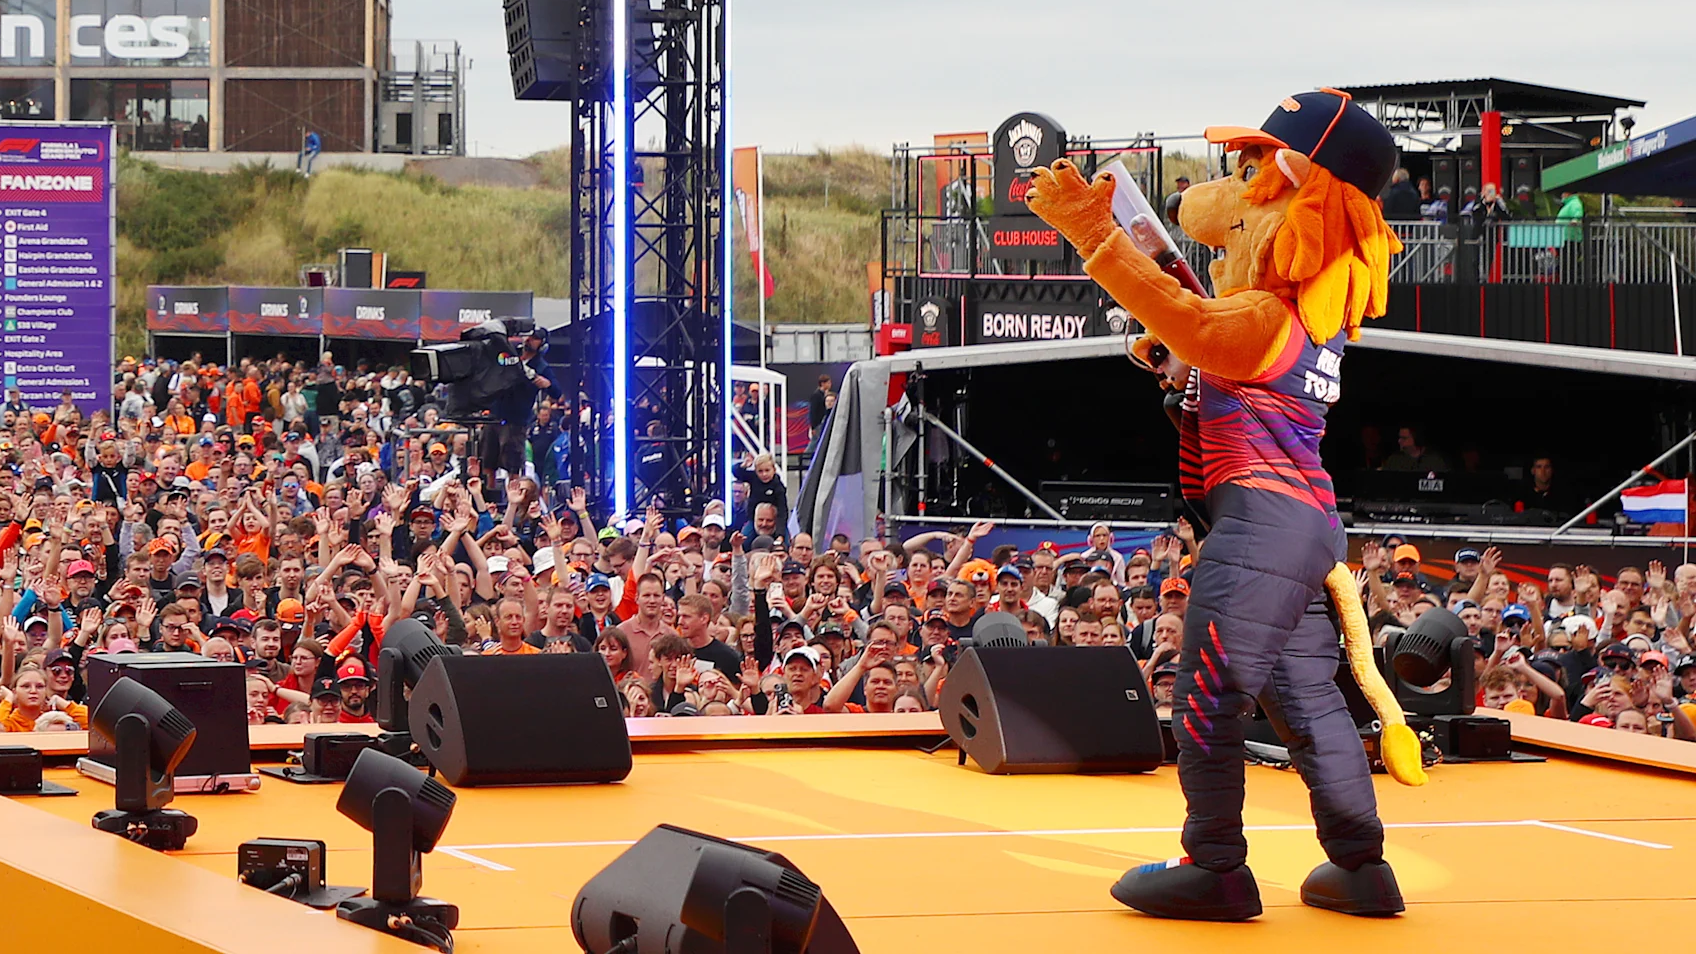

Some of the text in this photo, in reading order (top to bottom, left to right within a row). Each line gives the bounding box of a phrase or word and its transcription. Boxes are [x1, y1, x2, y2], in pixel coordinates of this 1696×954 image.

[0, 175, 94, 191] FANZONE
[17, 223, 49, 232] First Aid
[18, 237, 88, 246] Arena Grandstands
[994, 230, 1058, 246] CLUB HOUSE
[18, 252, 93, 261] Hairpin Grandstands
[18, 266, 97, 274] Eastside Grandstands
[17, 279, 46, 288] General
[46, 279, 84, 288] Admission
[4, 294, 67, 303] Founders Lounge
[17, 308, 74, 317] Champions Club
[173, 302, 199, 315] DRINKS
[261, 303, 289, 317] DRINKS
[355, 306, 386, 321] DRINKS
[458, 309, 492, 324] DRINKS
[32, 321, 57, 330] Village
[983, 313, 1028, 338] BORN
[1030, 314, 1087, 339] READY
[4, 349, 63, 359] Hospitality Area
[17, 378, 46, 386] General
[46, 378, 84, 386] Admission
